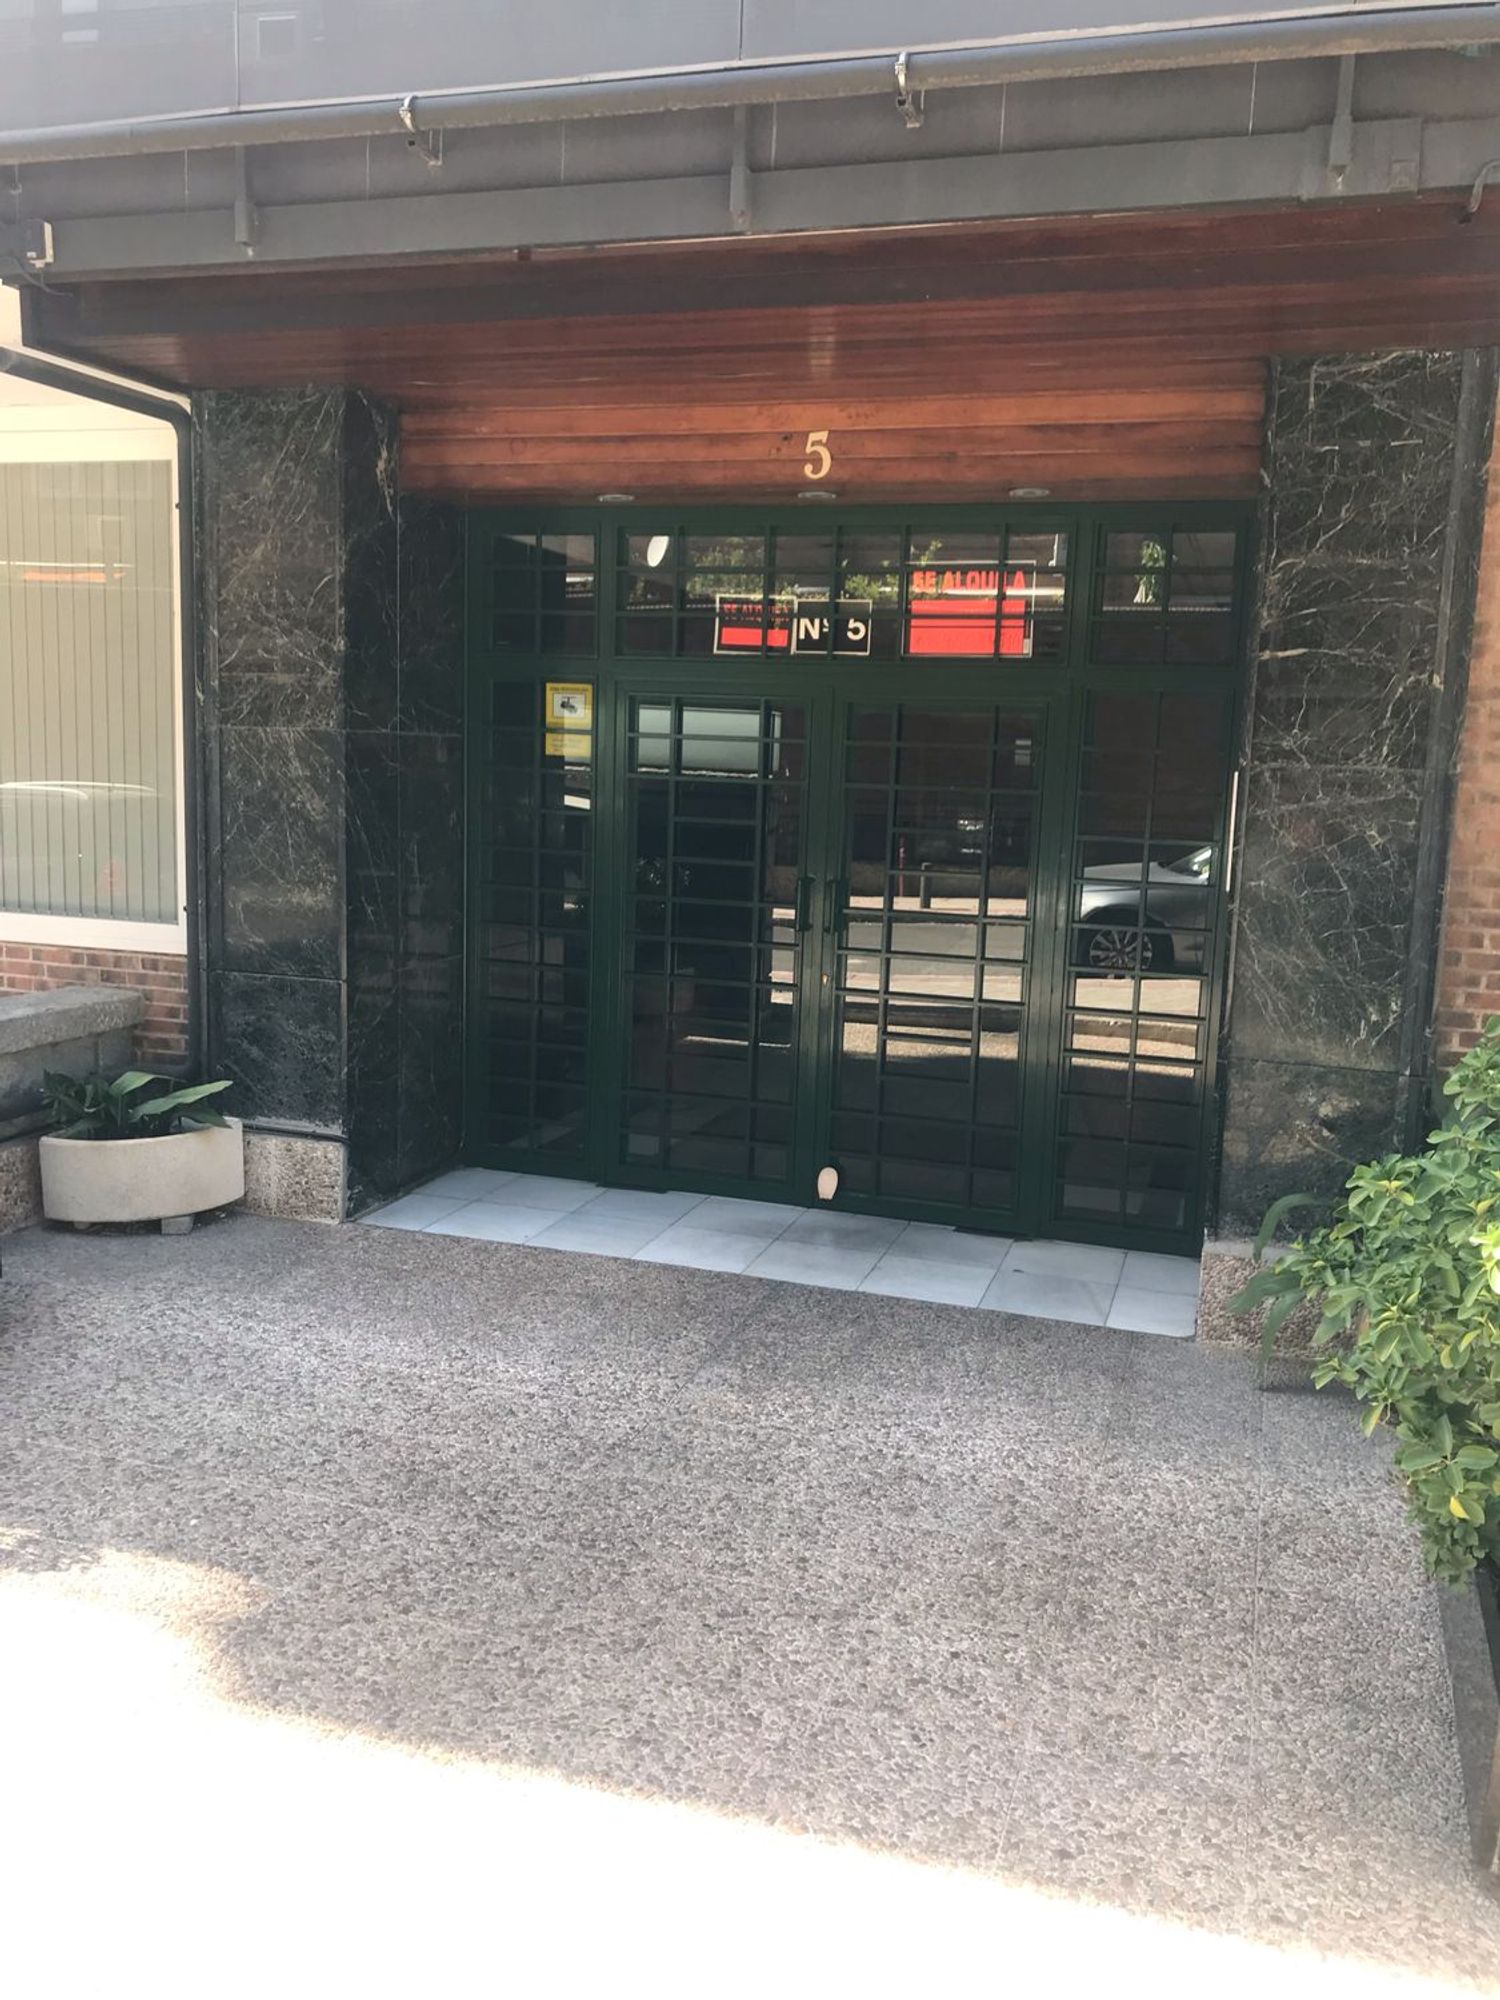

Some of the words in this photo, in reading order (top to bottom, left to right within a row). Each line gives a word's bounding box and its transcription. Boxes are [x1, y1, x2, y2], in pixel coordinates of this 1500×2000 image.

[804, 430, 832, 480] 5
[912, 571, 937, 592] SE
[847, 618, 866, 641] 5
